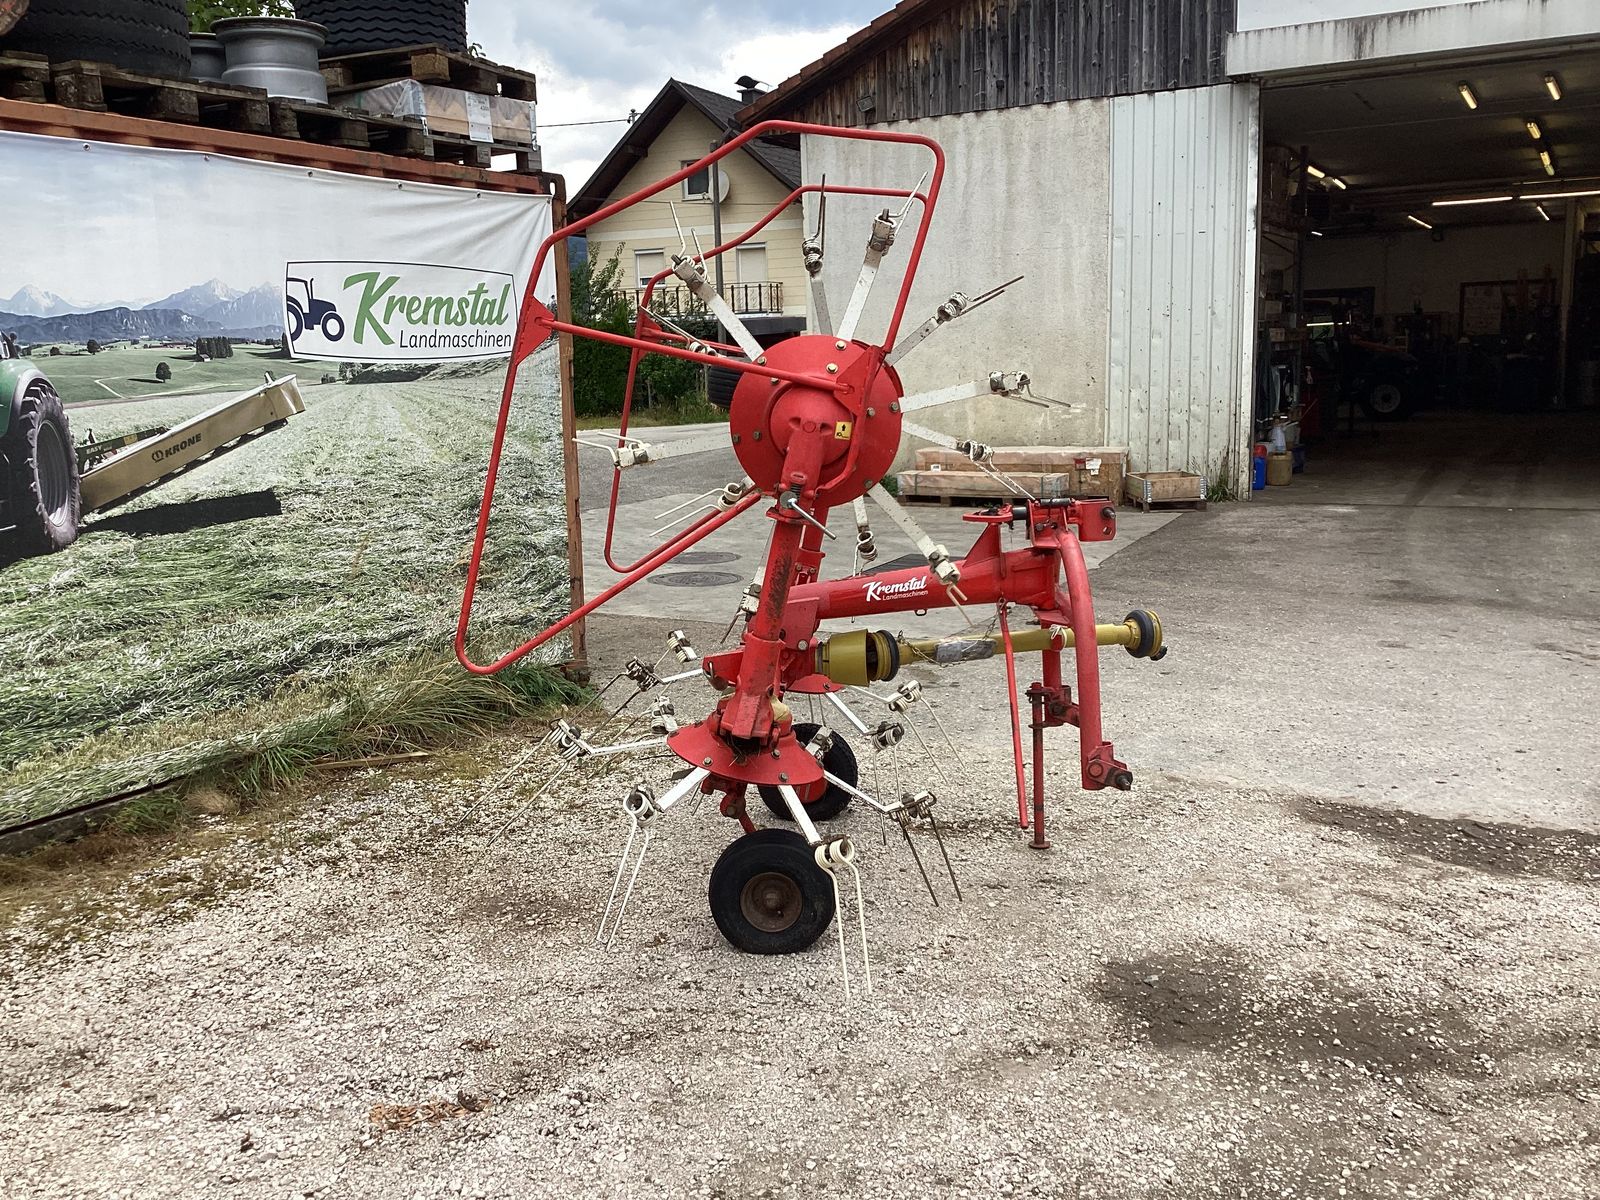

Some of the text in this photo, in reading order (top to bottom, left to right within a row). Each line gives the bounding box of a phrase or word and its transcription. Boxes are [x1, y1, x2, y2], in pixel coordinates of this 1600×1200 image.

[342, 271, 511, 346] Kremstal
[400, 329, 512, 349] Landmaschinen
[164, 433, 202, 458] KRONE
[862, 575, 927, 602] Kremstal
[882, 590, 929, 601] Landmaschinen
